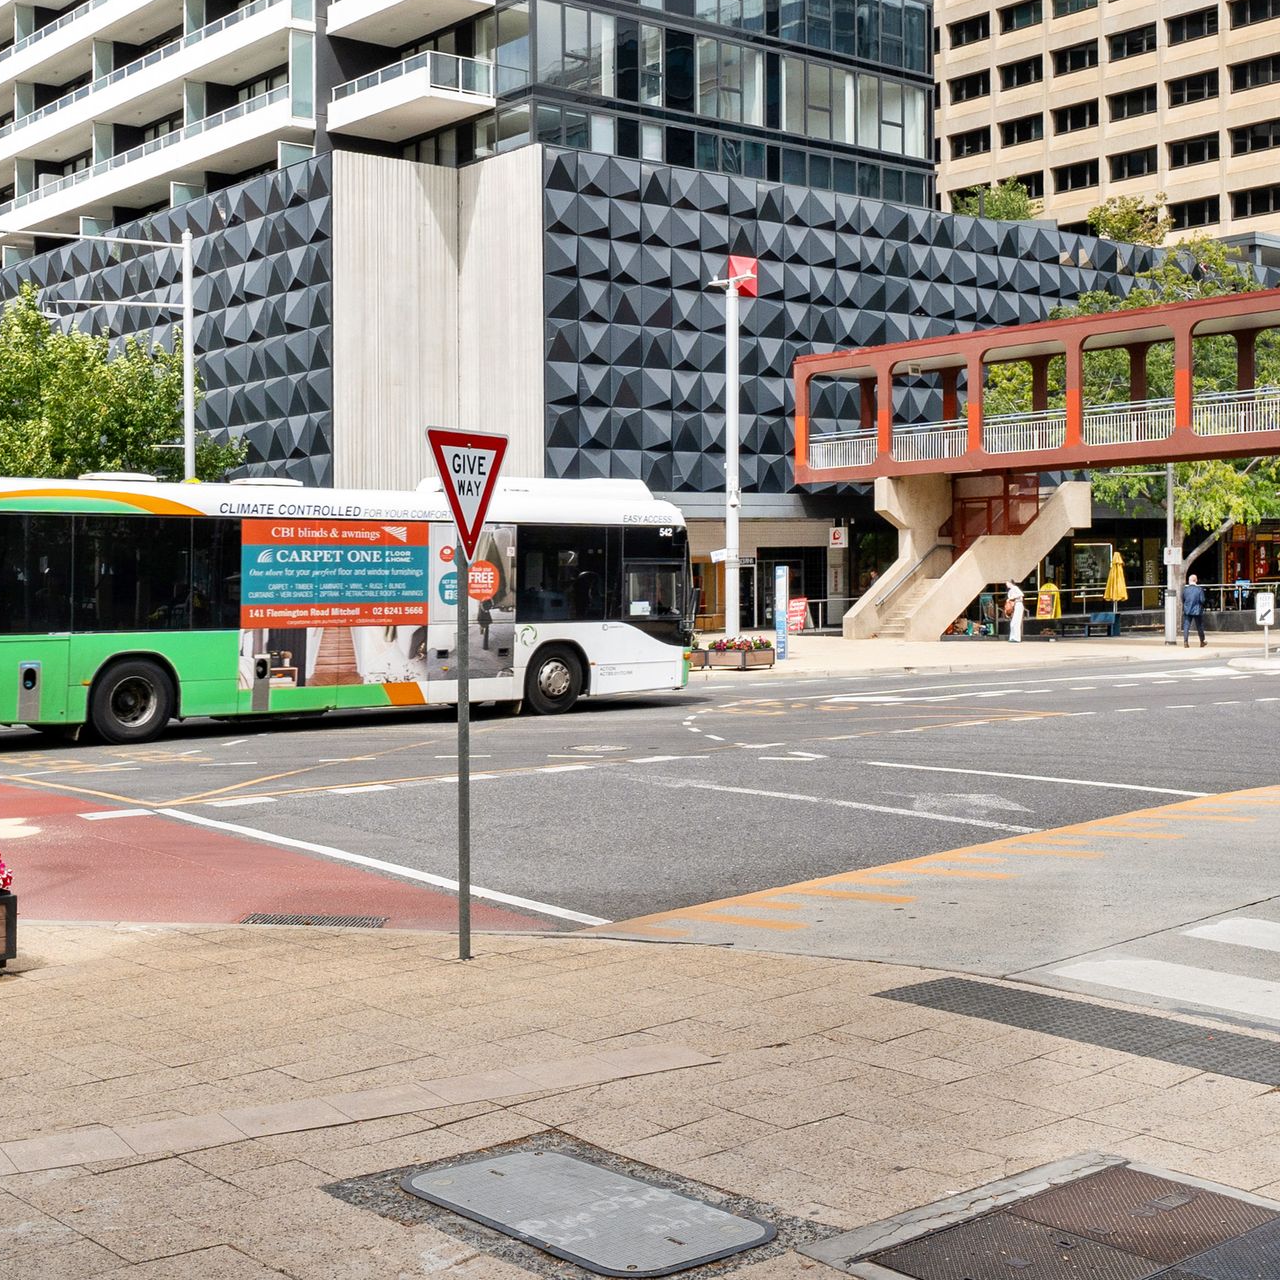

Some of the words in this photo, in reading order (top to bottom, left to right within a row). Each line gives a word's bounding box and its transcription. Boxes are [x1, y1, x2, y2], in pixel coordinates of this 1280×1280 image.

[452, 453, 487, 476] GIVE
[457, 479, 482, 497] WAY
[219, 502, 275, 515] CLIMATE
[278, 504, 362, 517] CONTROLLED
[363, 508, 382, 518] FOR
[384, 509, 409, 518] YOUR
[623, 514, 642, 523] EASY
[643, 515, 673, 524] ACCESS
[271, 526, 294, 538] CBI
[298, 526, 328, 538] blinds
[329, 528, 339, 539] &
[341, 528, 381, 541] awnings
[659, 528, 673, 537] 542
[276, 550, 344, 563] CARPET
[347, 550, 383, 564] ONE
[249, 569, 263, 577] One
[284, 568, 294, 576] for
[296, 569, 310, 578] your
[337, 568, 352, 576] floor
[354, 568, 366, 576] and
[367, 568, 390, 576] window
[391, 568, 424, 577] furnishings
[468, 572, 494, 583] FREE
[249, 609, 264, 618] 141
[267, 608, 308, 618] Flemington
[310, 607, 329, 616] Road
[331, 607, 360, 616] Mitchell
[372, 607, 383, 615] 02
[384, 607, 402, 615] 6241
[404, 606, 423, 615] 5666
